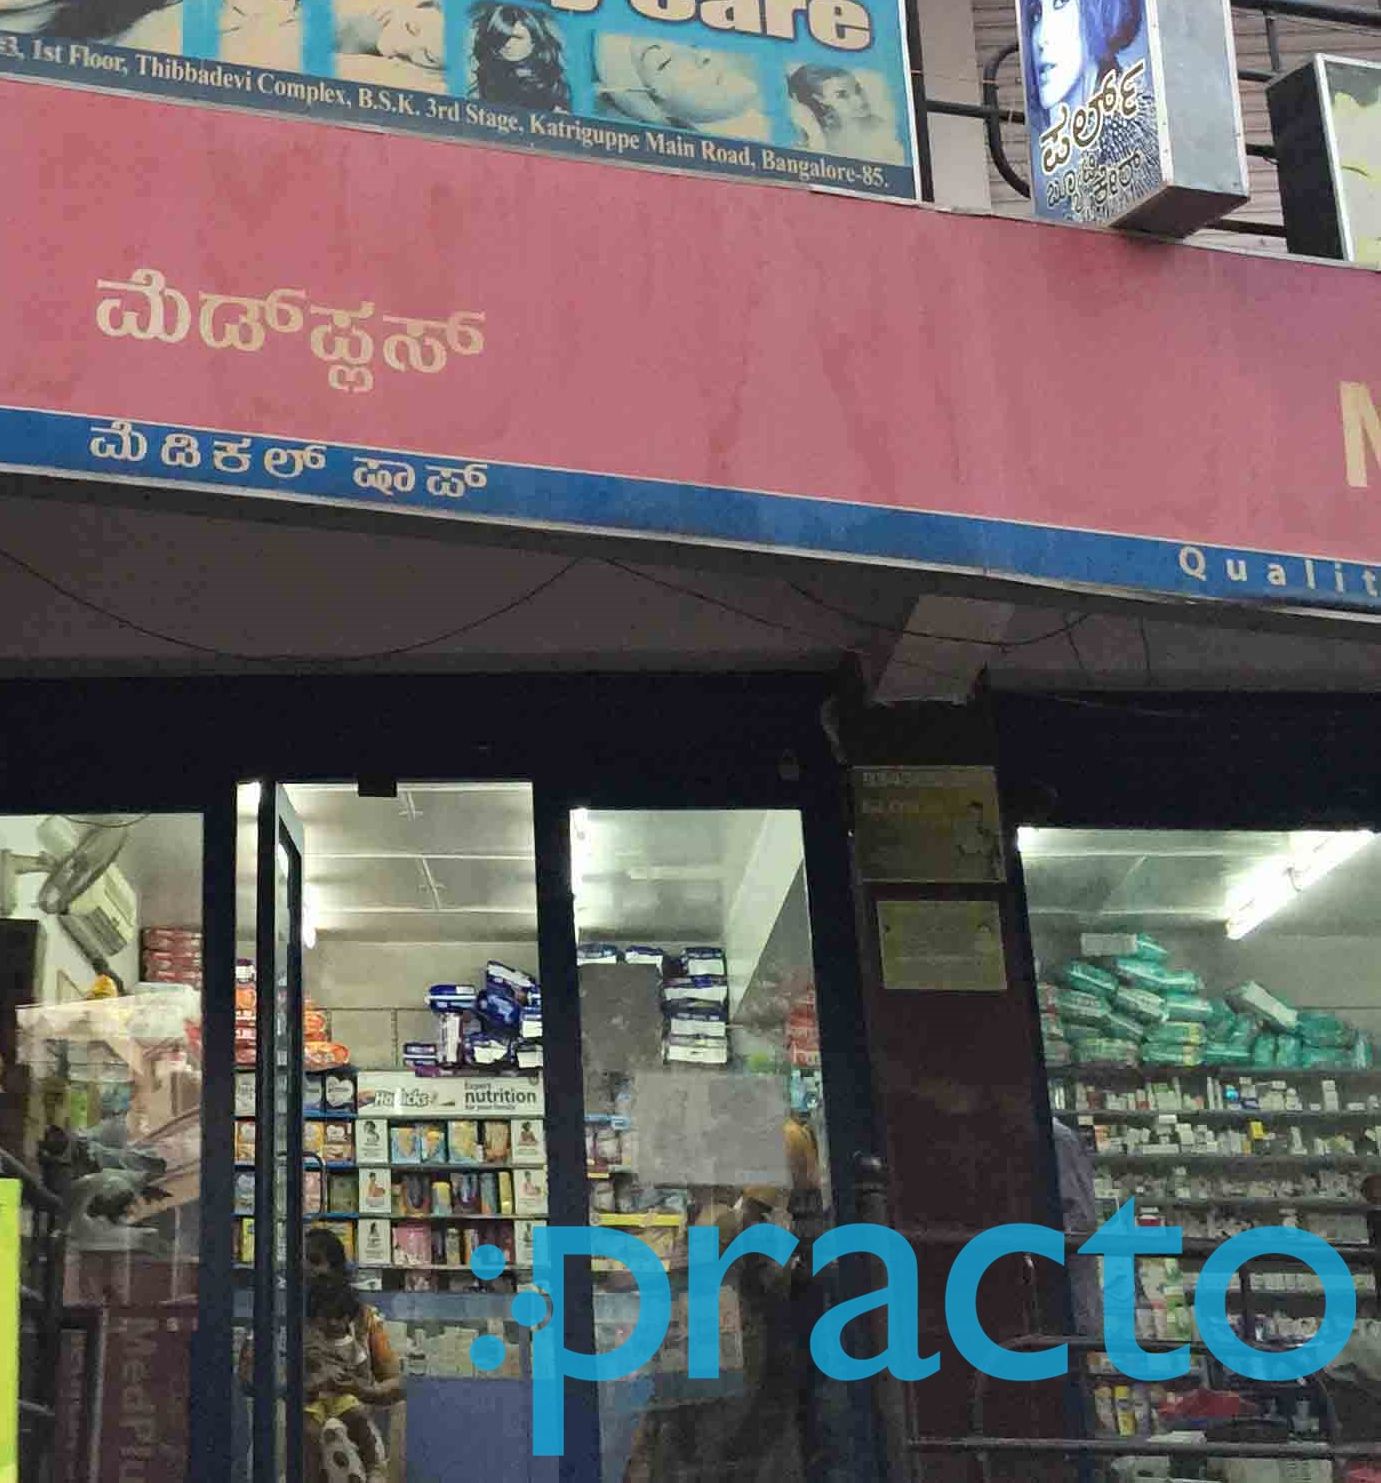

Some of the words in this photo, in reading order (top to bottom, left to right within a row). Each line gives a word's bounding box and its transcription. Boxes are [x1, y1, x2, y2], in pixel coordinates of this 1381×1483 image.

[32, 39, 62, 64] 1st
[68, 44, 130, 74] Floor,
[135, 54, 254, 94] Thibbadevi
[257, 72, 353, 109] Complex,
[358, 85, 421, 117] B.S.K.
[424, 96, 461, 123] 3rd
[529, 112, 641, 152] Katriguppe
[644, 131, 696, 160] Main
[701, 141, 756, 170] Road,
[762, 150, 890, 189] Bangalore-85.
[89, 419, 328, 479] ಮೆಡಿಕಲ್
[375, 1087, 438, 1108] Holicks
[464, 1089, 537, 1105] nutrition
